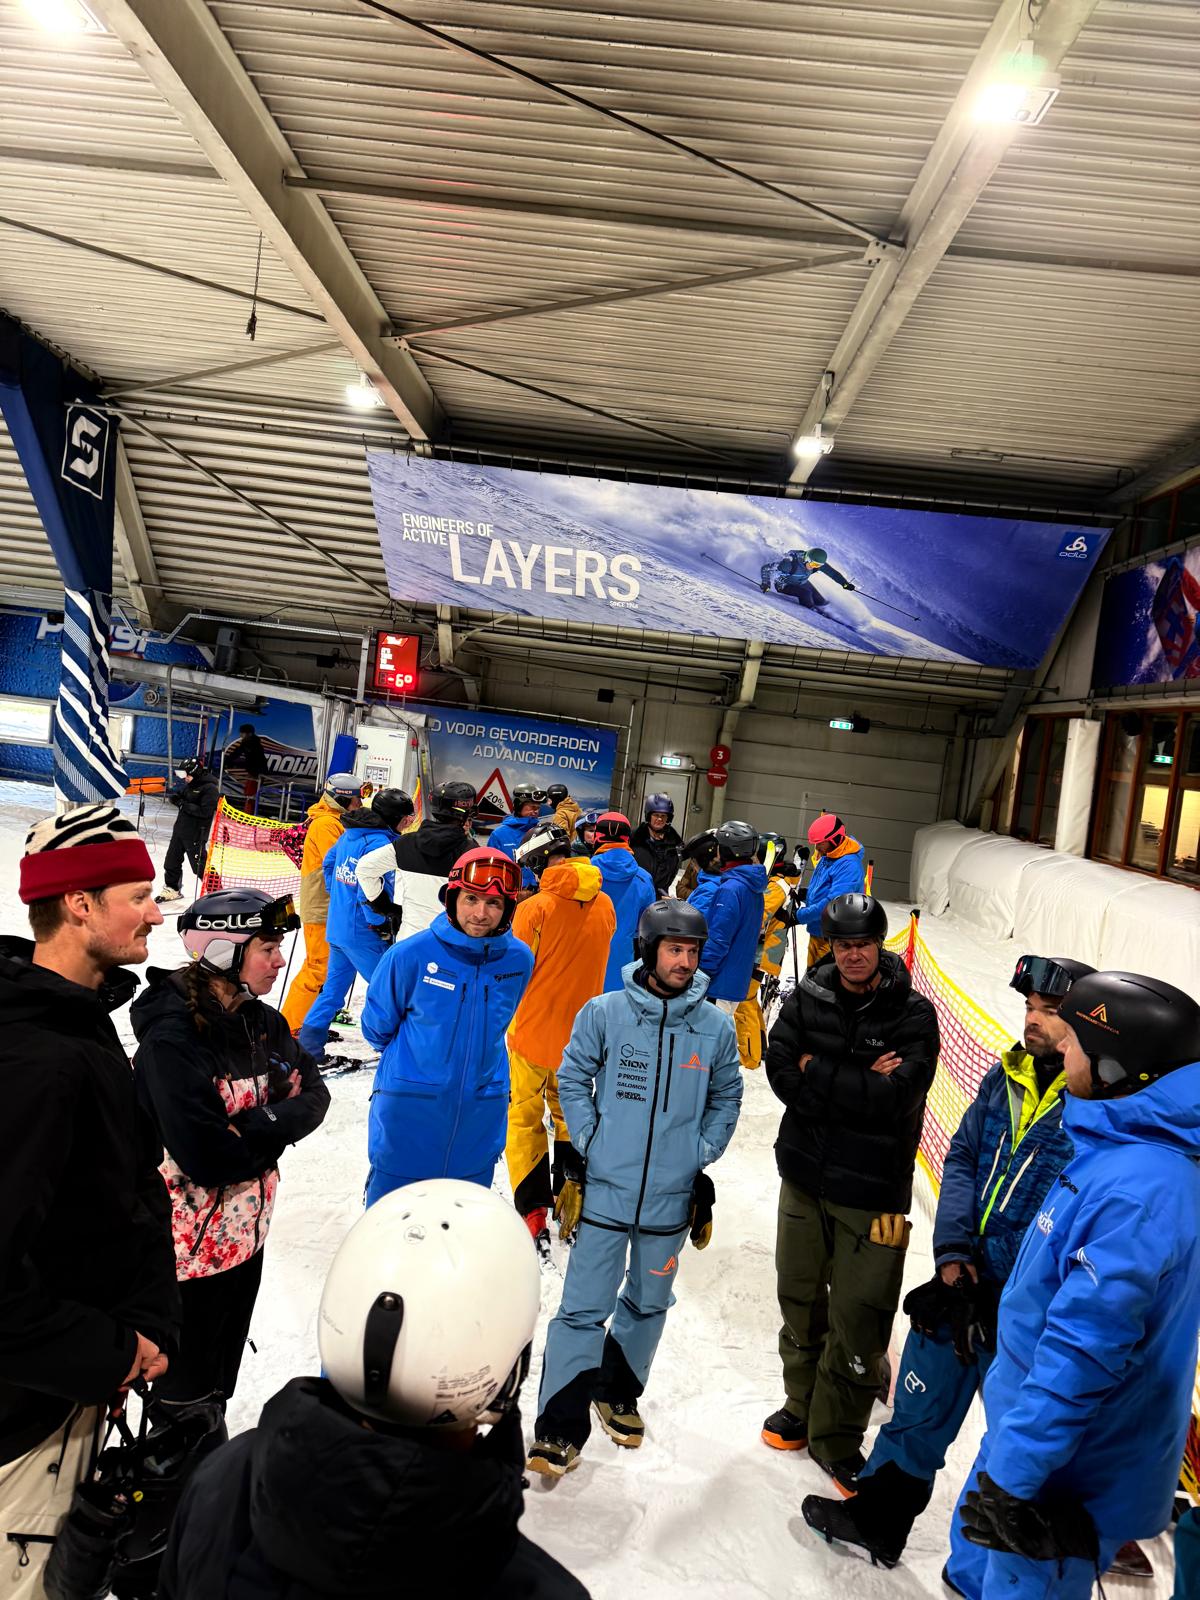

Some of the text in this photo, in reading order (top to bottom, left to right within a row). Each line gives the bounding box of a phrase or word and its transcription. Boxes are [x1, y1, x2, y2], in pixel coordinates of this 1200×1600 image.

[402, 513, 494, 537] ENGINEERS OF
[402, 528, 448, 546] ACTIVE
[449, 534, 642, 602] LAYERS
[446, 721, 485, 738] VOOR
[489, 727, 600, 753] GEVORDERDEN
[472, 745, 598, 772] ADVANCED ONLY
[716, 750, 724, 760] 3
[486, 791, 504, 809] 20%
[196, 912, 262, 930] bollé
[619, 1058, 649, 1071] XION
[616, 1081, 647, 1091] SALOMON
[622, 1073, 647, 1083] PROTEST
